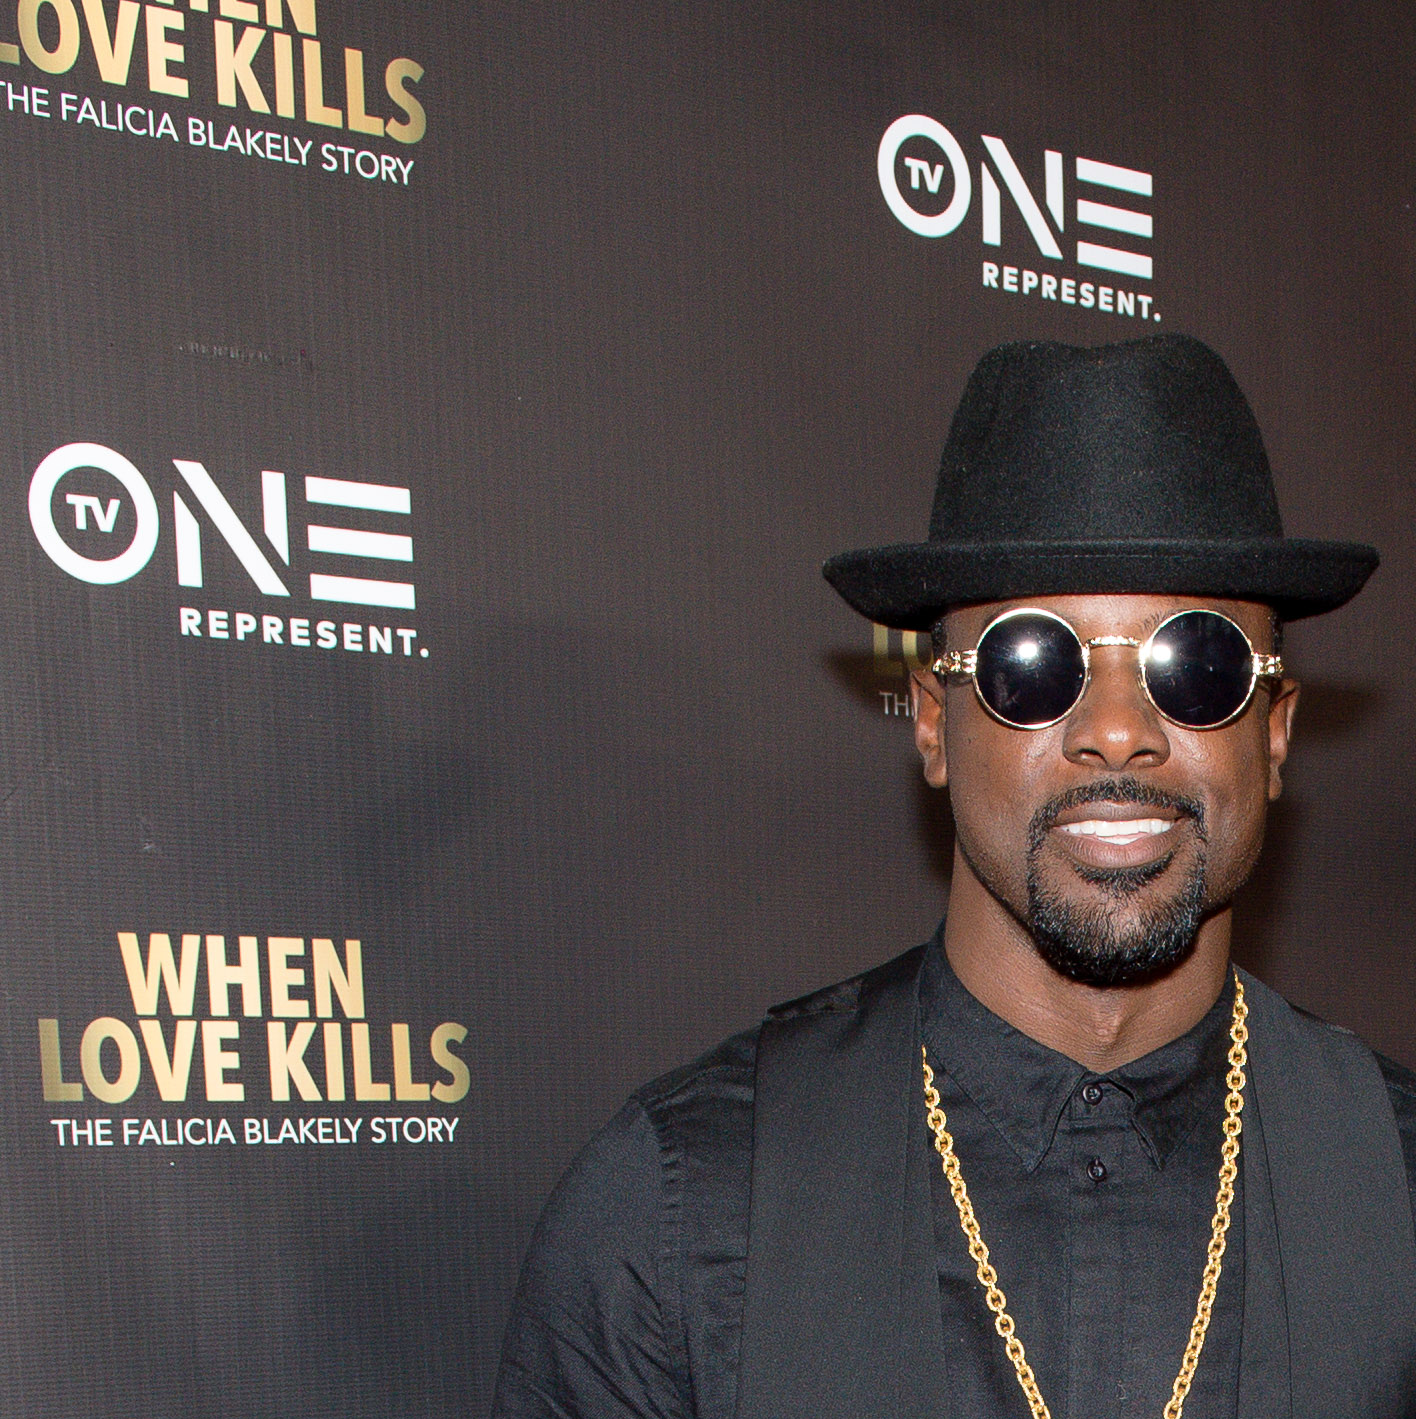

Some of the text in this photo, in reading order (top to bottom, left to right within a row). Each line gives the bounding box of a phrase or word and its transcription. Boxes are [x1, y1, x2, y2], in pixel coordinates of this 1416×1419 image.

[0, 0, 427, 144] OVE KILLS
[0, 81, 414, 185] HE FALICIA BLAKELY STORY
[878, 114, 1152, 278] ONE
[905, 157, 943, 193] TV
[983, 261, 1160, 320] REPRESENT.
[28, 443, 415, 609] ONE
[66, 494, 120, 532] TV
[180, 607, 428, 657] REPRESENT.
[879, 690, 915, 717] TH
[117, 931, 365, 1019] WHEN
[38, 1016, 470, 1104] LOVE KILLS
[50, 1117, 459, 1146] THE FALICIA BLAKELY STORY
